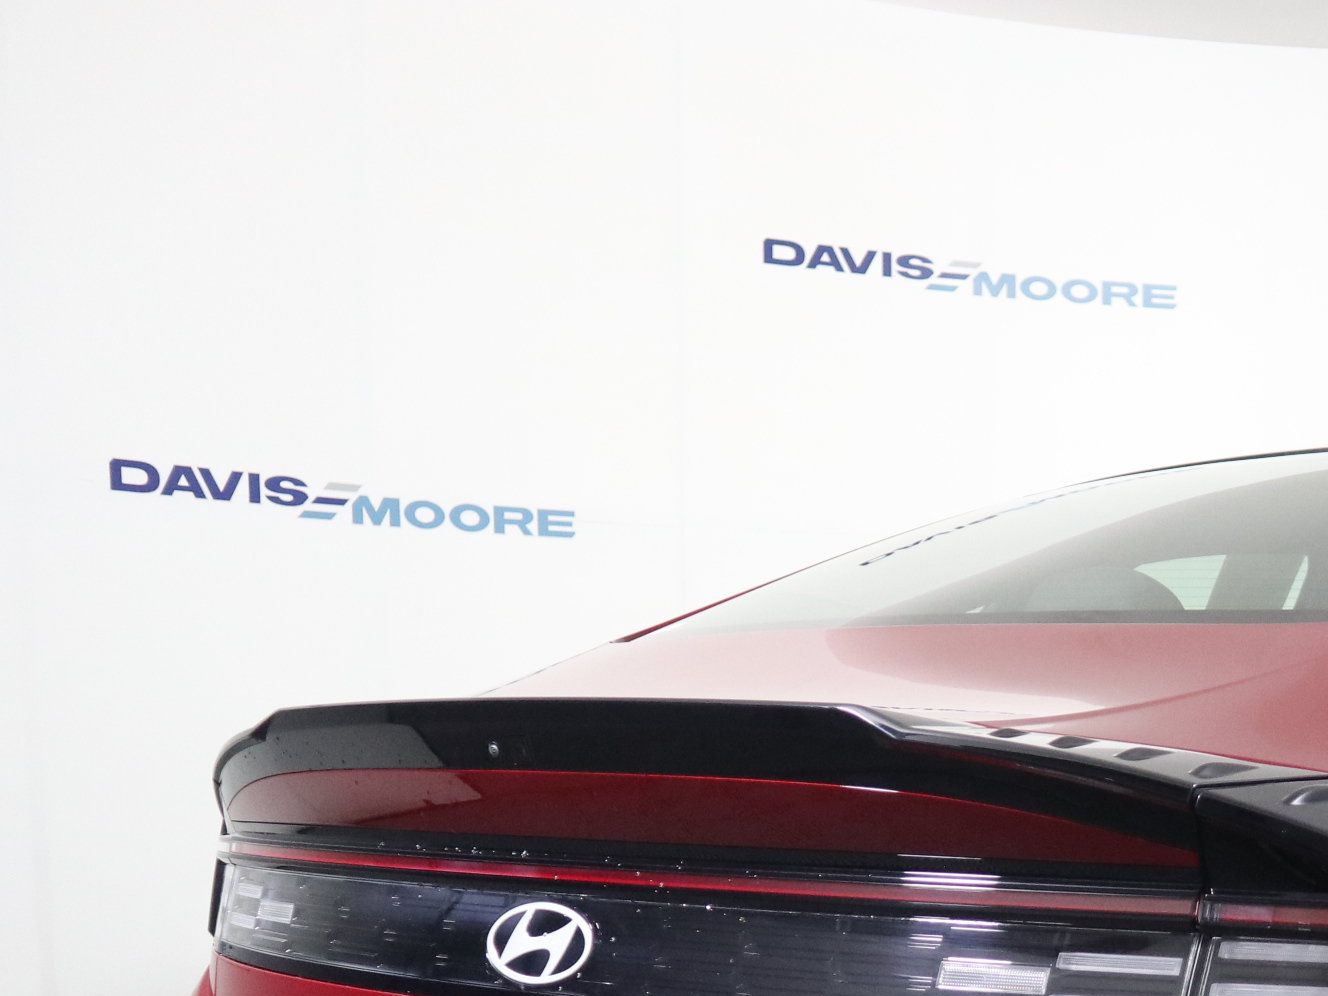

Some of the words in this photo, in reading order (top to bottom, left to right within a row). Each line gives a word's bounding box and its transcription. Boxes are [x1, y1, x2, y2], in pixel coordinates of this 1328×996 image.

[763, 238, 935, 282] DAVIS
[972, 271, 1177, 310] MOORE
[109, 458, 309, 508] DAVIS
[351, 495, 576, 539] MOORE
